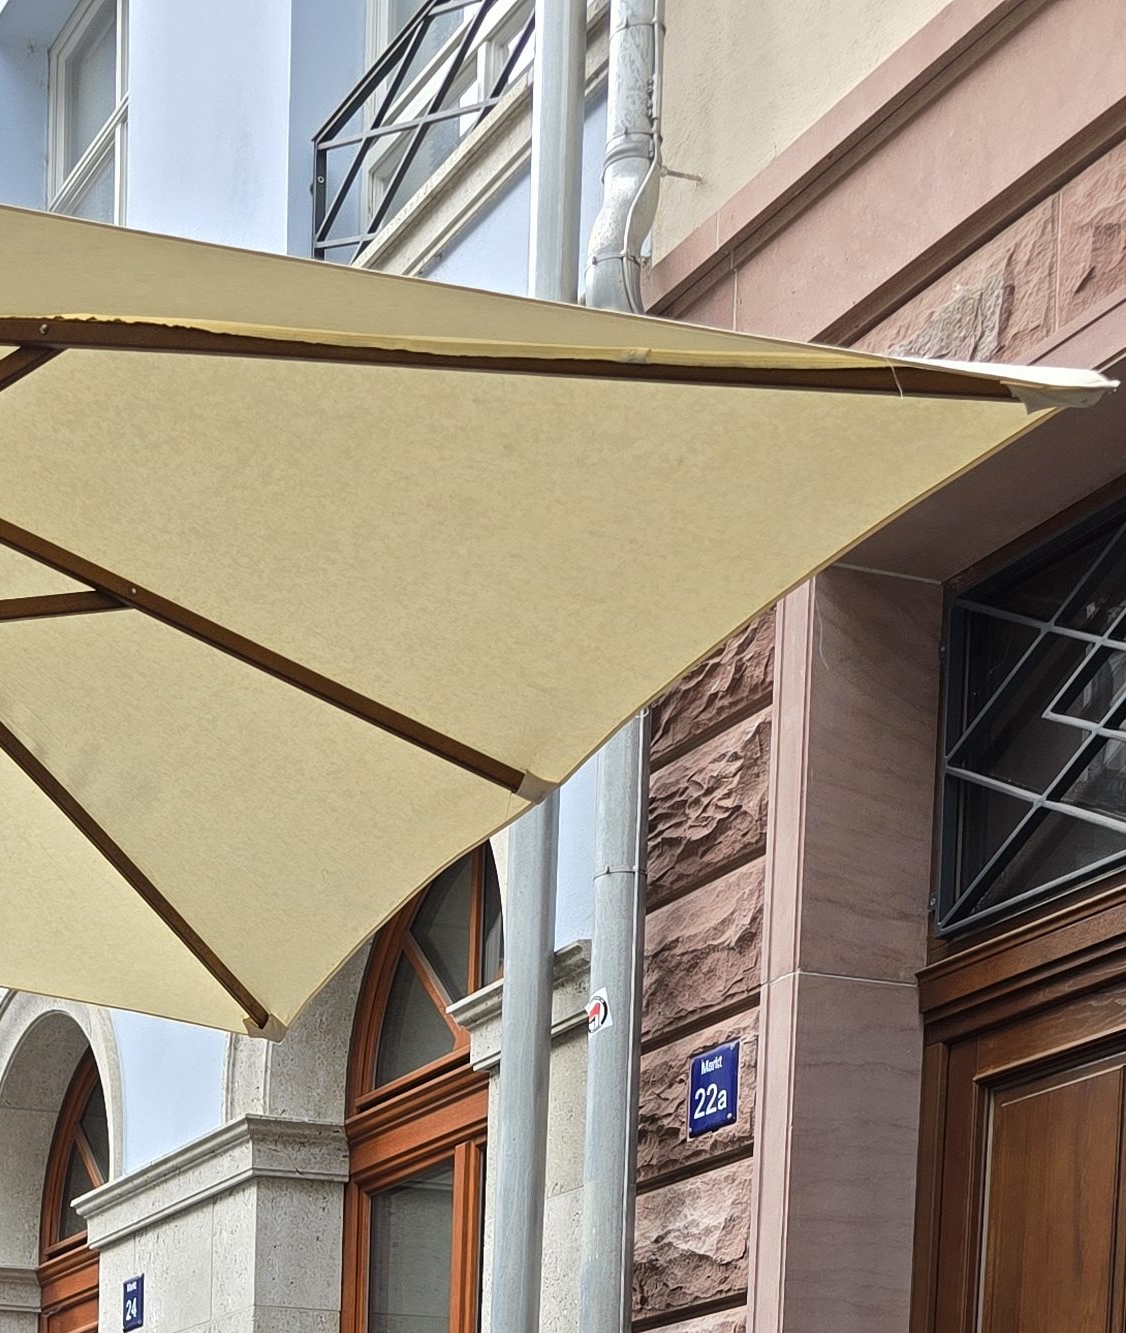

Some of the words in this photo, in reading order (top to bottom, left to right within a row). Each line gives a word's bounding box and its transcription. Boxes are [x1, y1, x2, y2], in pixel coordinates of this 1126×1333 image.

[700, 1056, 723, 1075] Markt
[694, 1083, 727, 1119] 22a
[125, 1297, 137, 1320] 24
